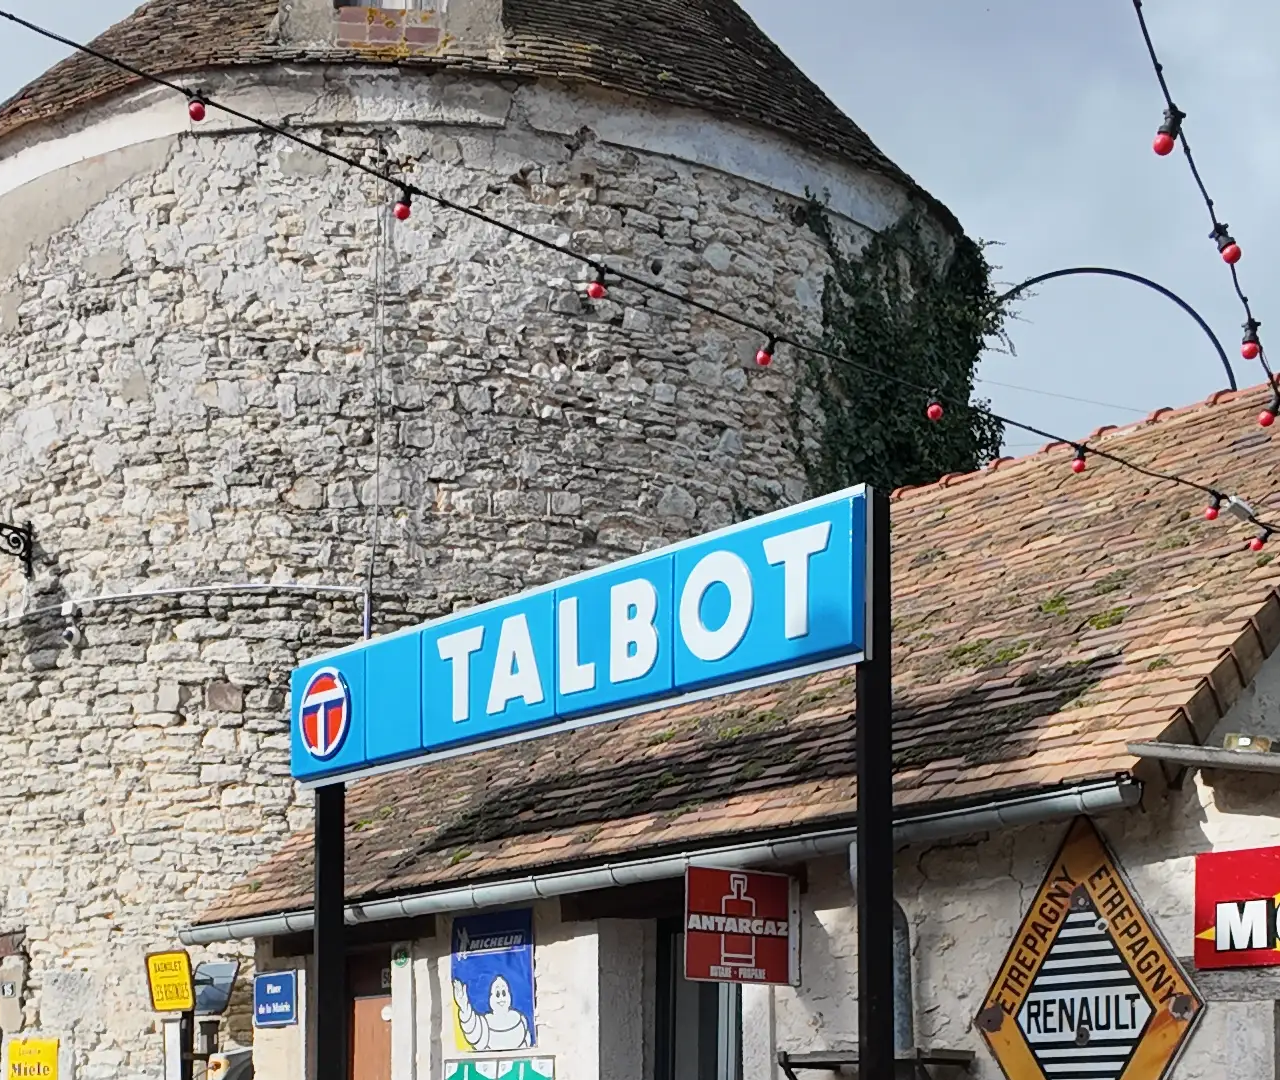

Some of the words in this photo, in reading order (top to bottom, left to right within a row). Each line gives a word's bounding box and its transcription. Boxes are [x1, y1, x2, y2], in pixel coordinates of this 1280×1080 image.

[437, 521, 831, 723] TALBOT
[688, 914, 788, 936] ANTARGAZ
[470, 935, 522, 949] MICHELIN
[1027, 993, 1141, 1034] RENAULT
[11, 1062, 50, 1077] Miele
